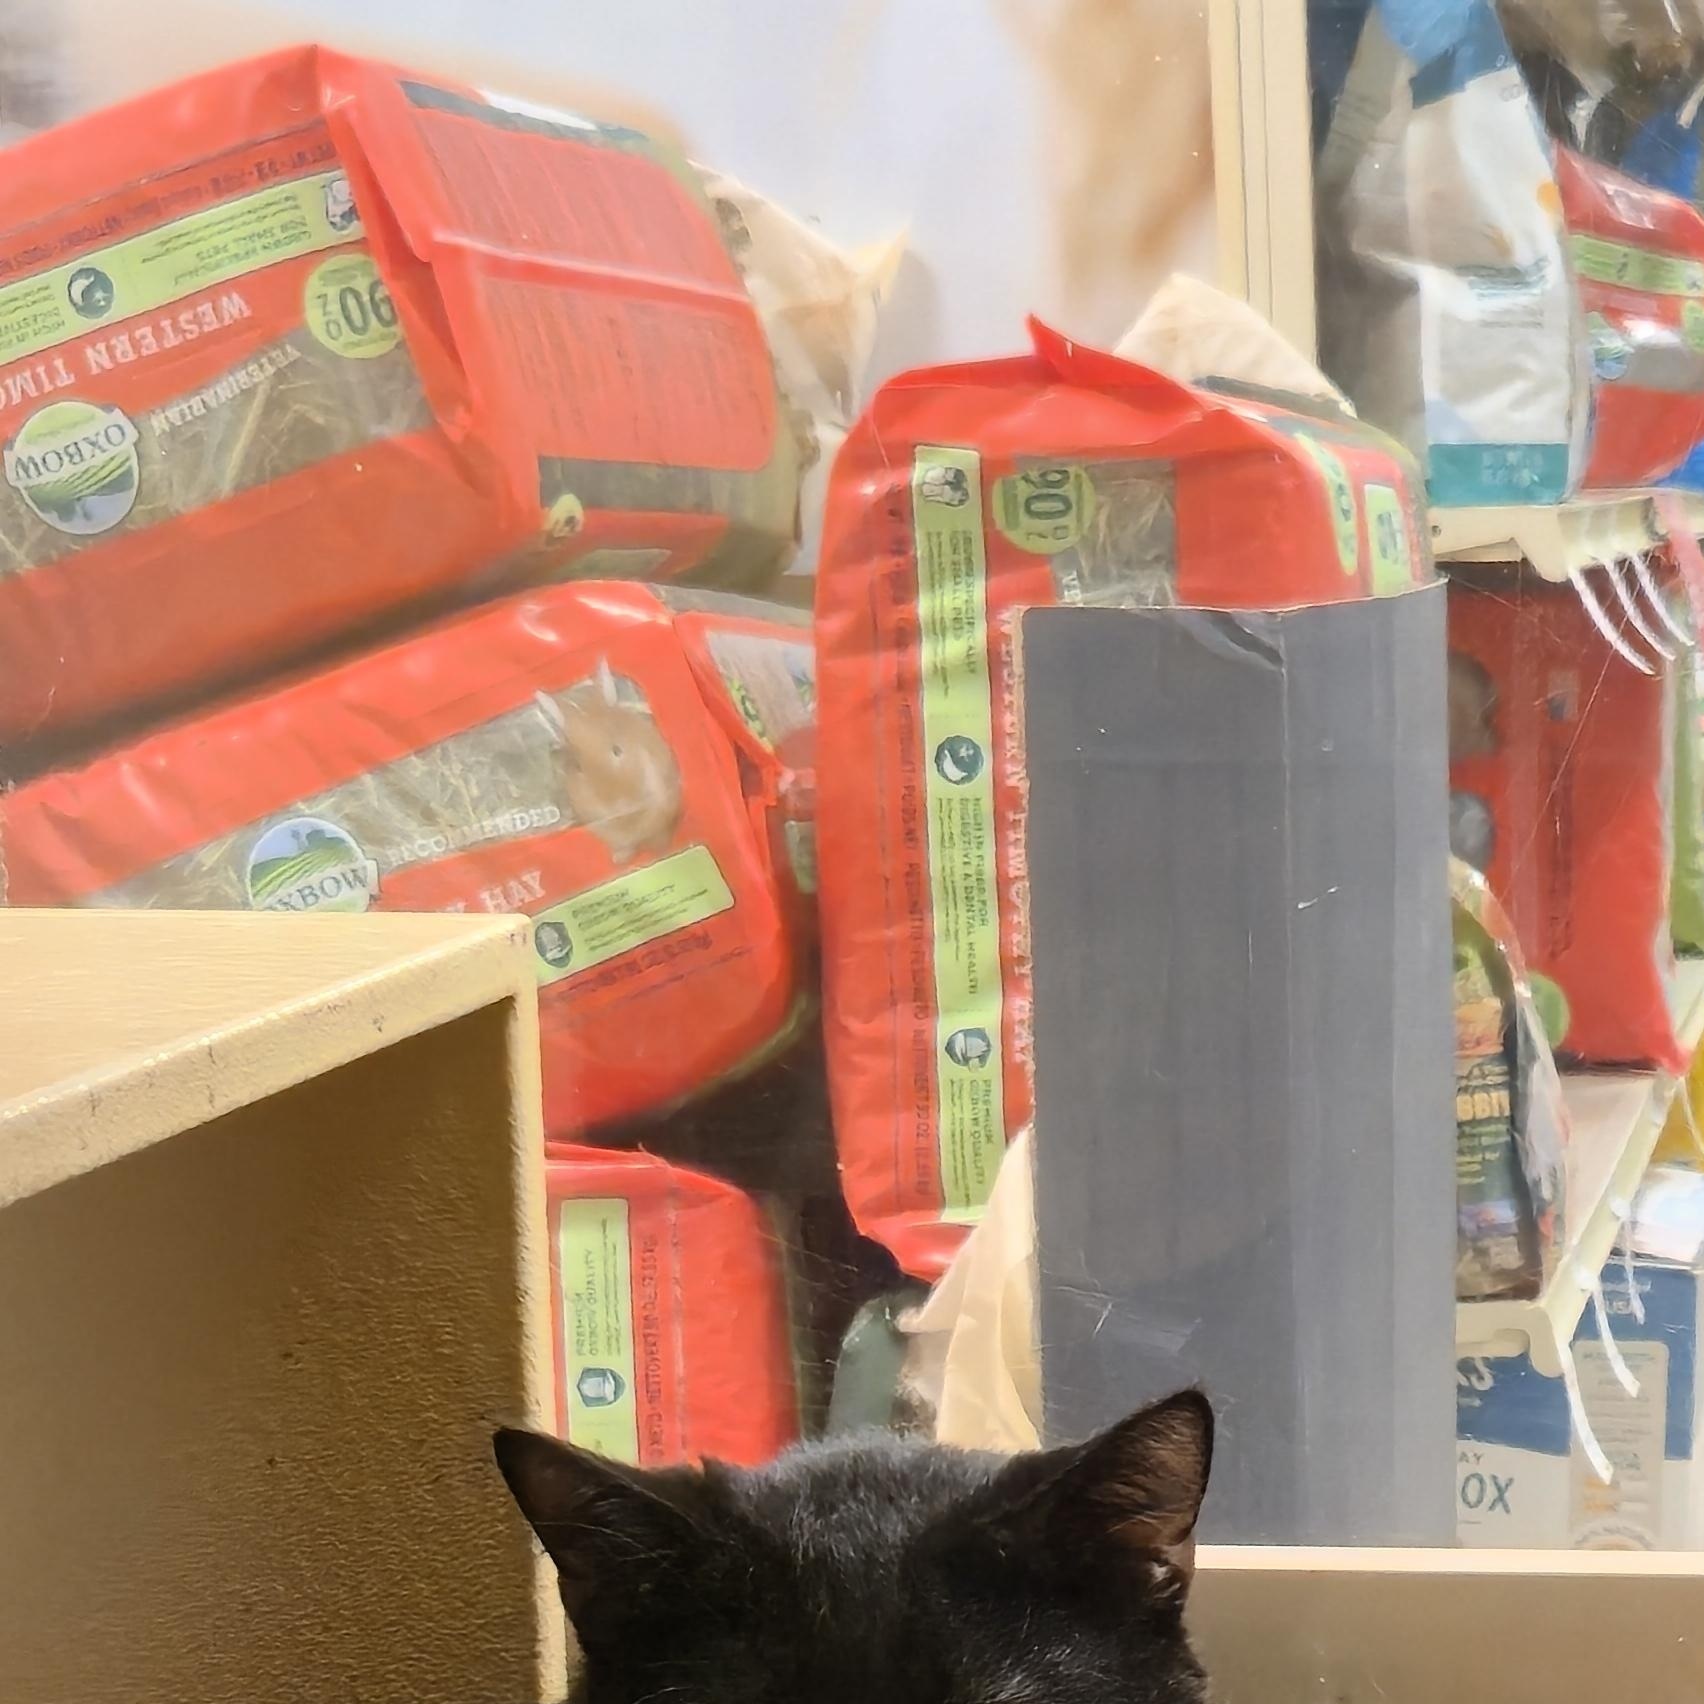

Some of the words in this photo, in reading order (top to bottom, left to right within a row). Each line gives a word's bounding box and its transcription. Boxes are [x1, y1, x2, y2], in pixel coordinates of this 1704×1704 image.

[85, 291, 252, 376] WESTERN
[338, 278, 399, 337] 90
[149, 342, 302, 437] VETERINARIAN
[15, 423, 126, 480] OXBOW
[1021, 469, 1073, 520] 90
[264, 868, 368, 912] XBOW
[480, 870, 547, 915] HAY
